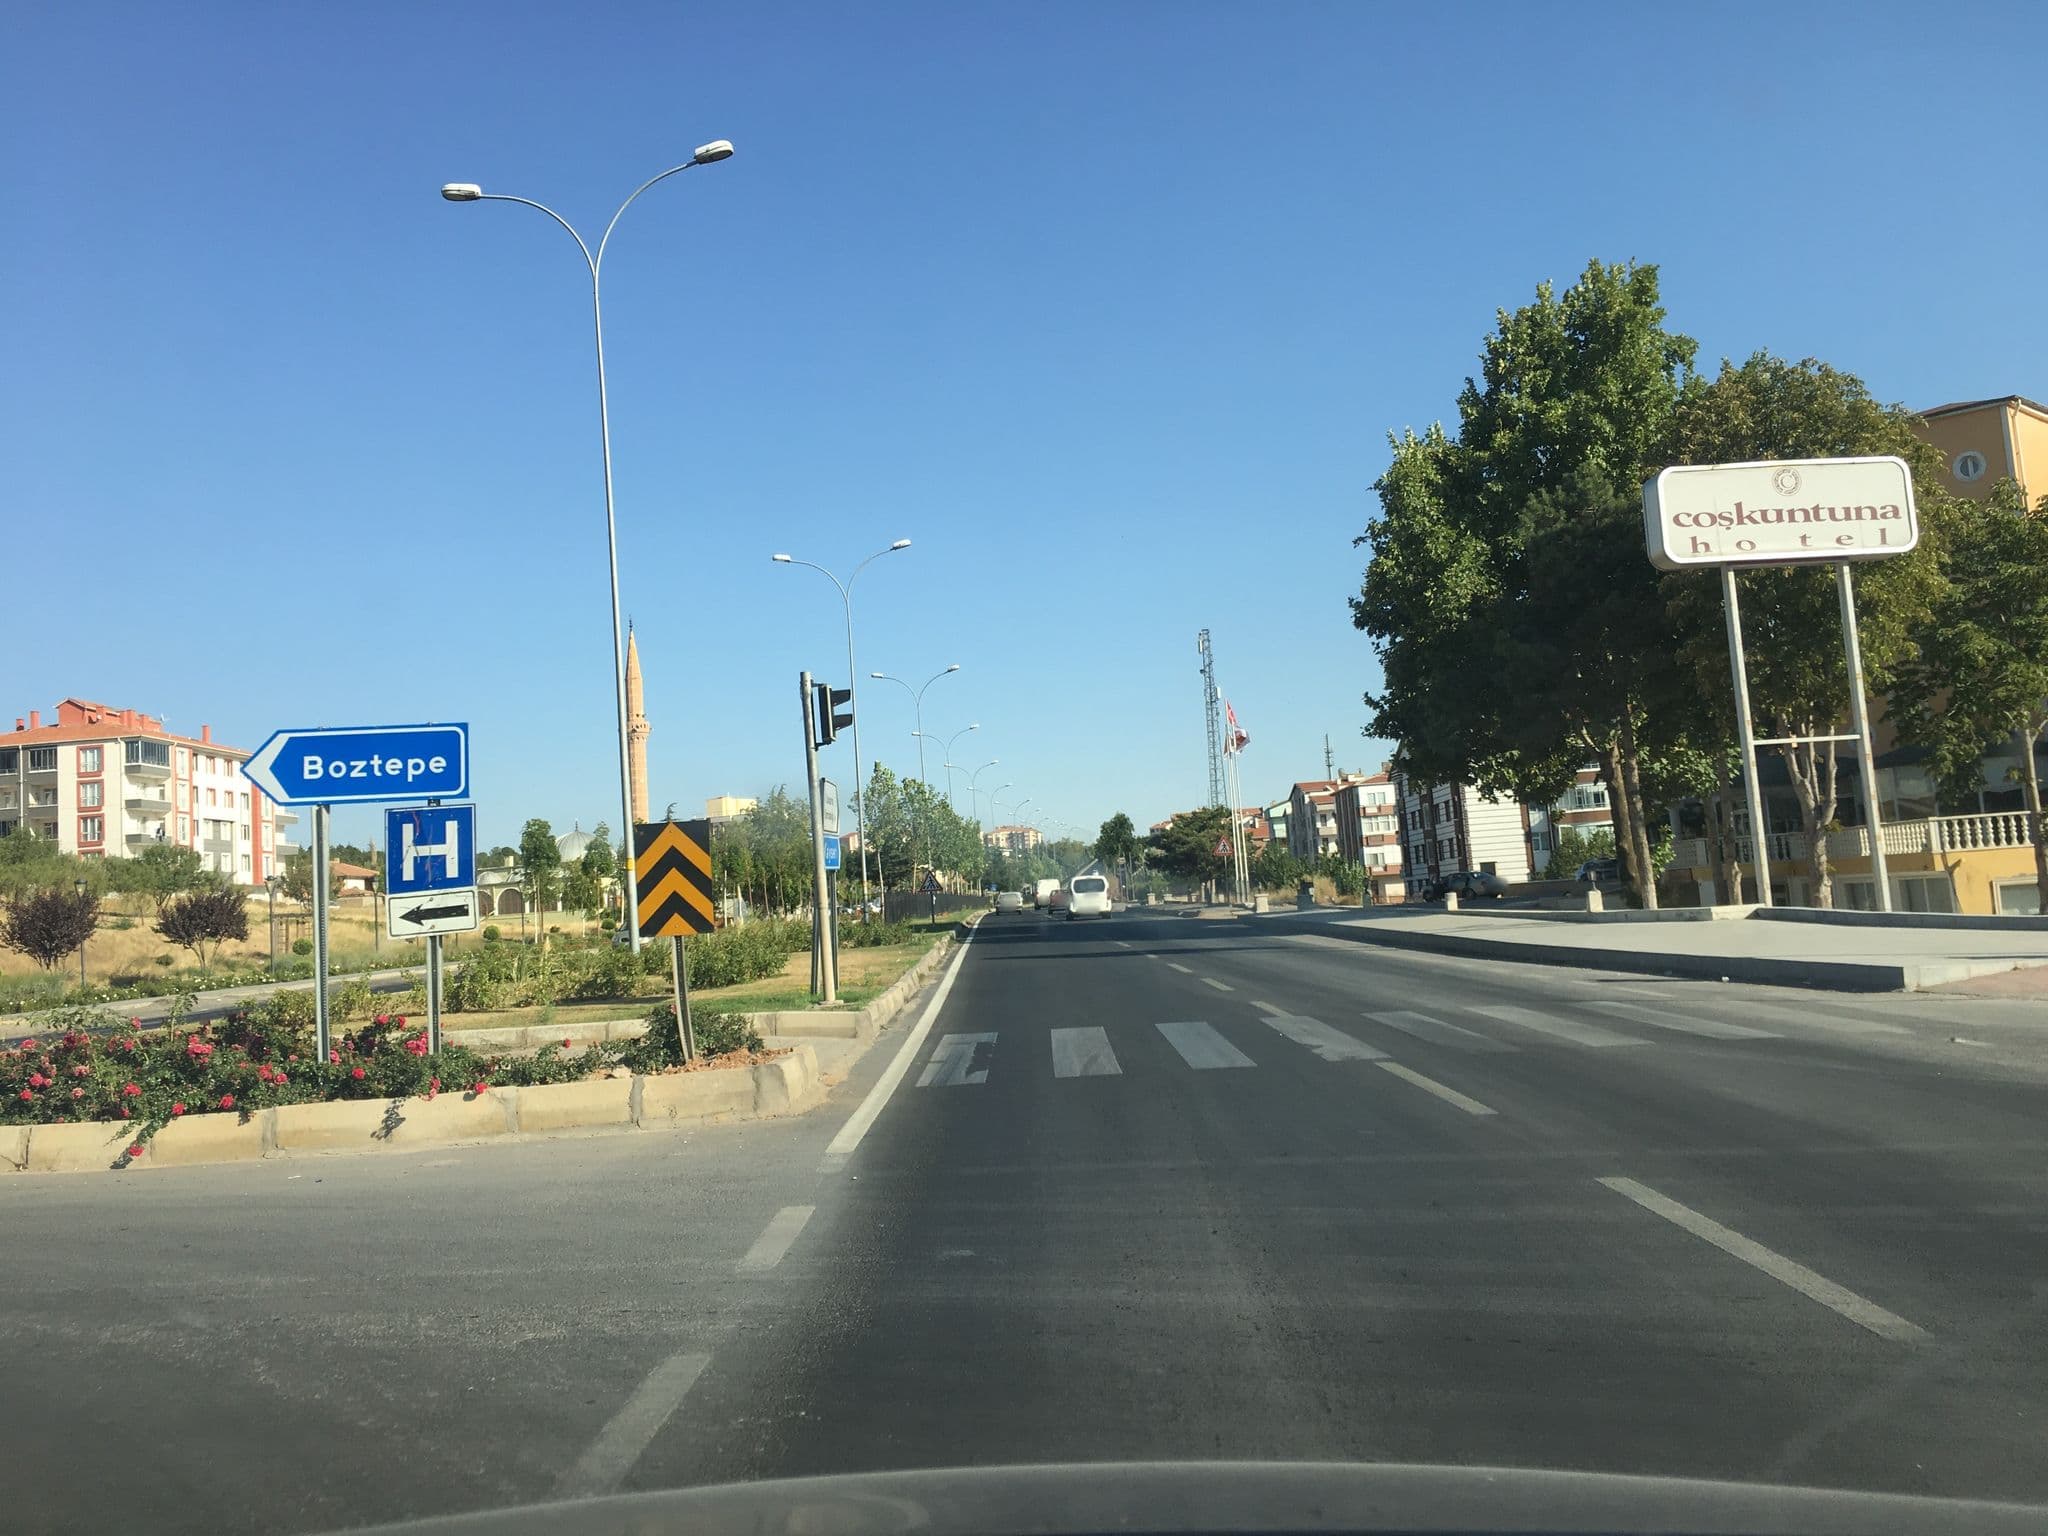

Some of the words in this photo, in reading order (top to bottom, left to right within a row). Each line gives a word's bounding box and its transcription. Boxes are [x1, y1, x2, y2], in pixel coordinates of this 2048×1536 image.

[1672, 501, 1902, 531] coşkuntuna
[303, 754, 447, 783] Boztepe
[402, 820, 459, 882] H
